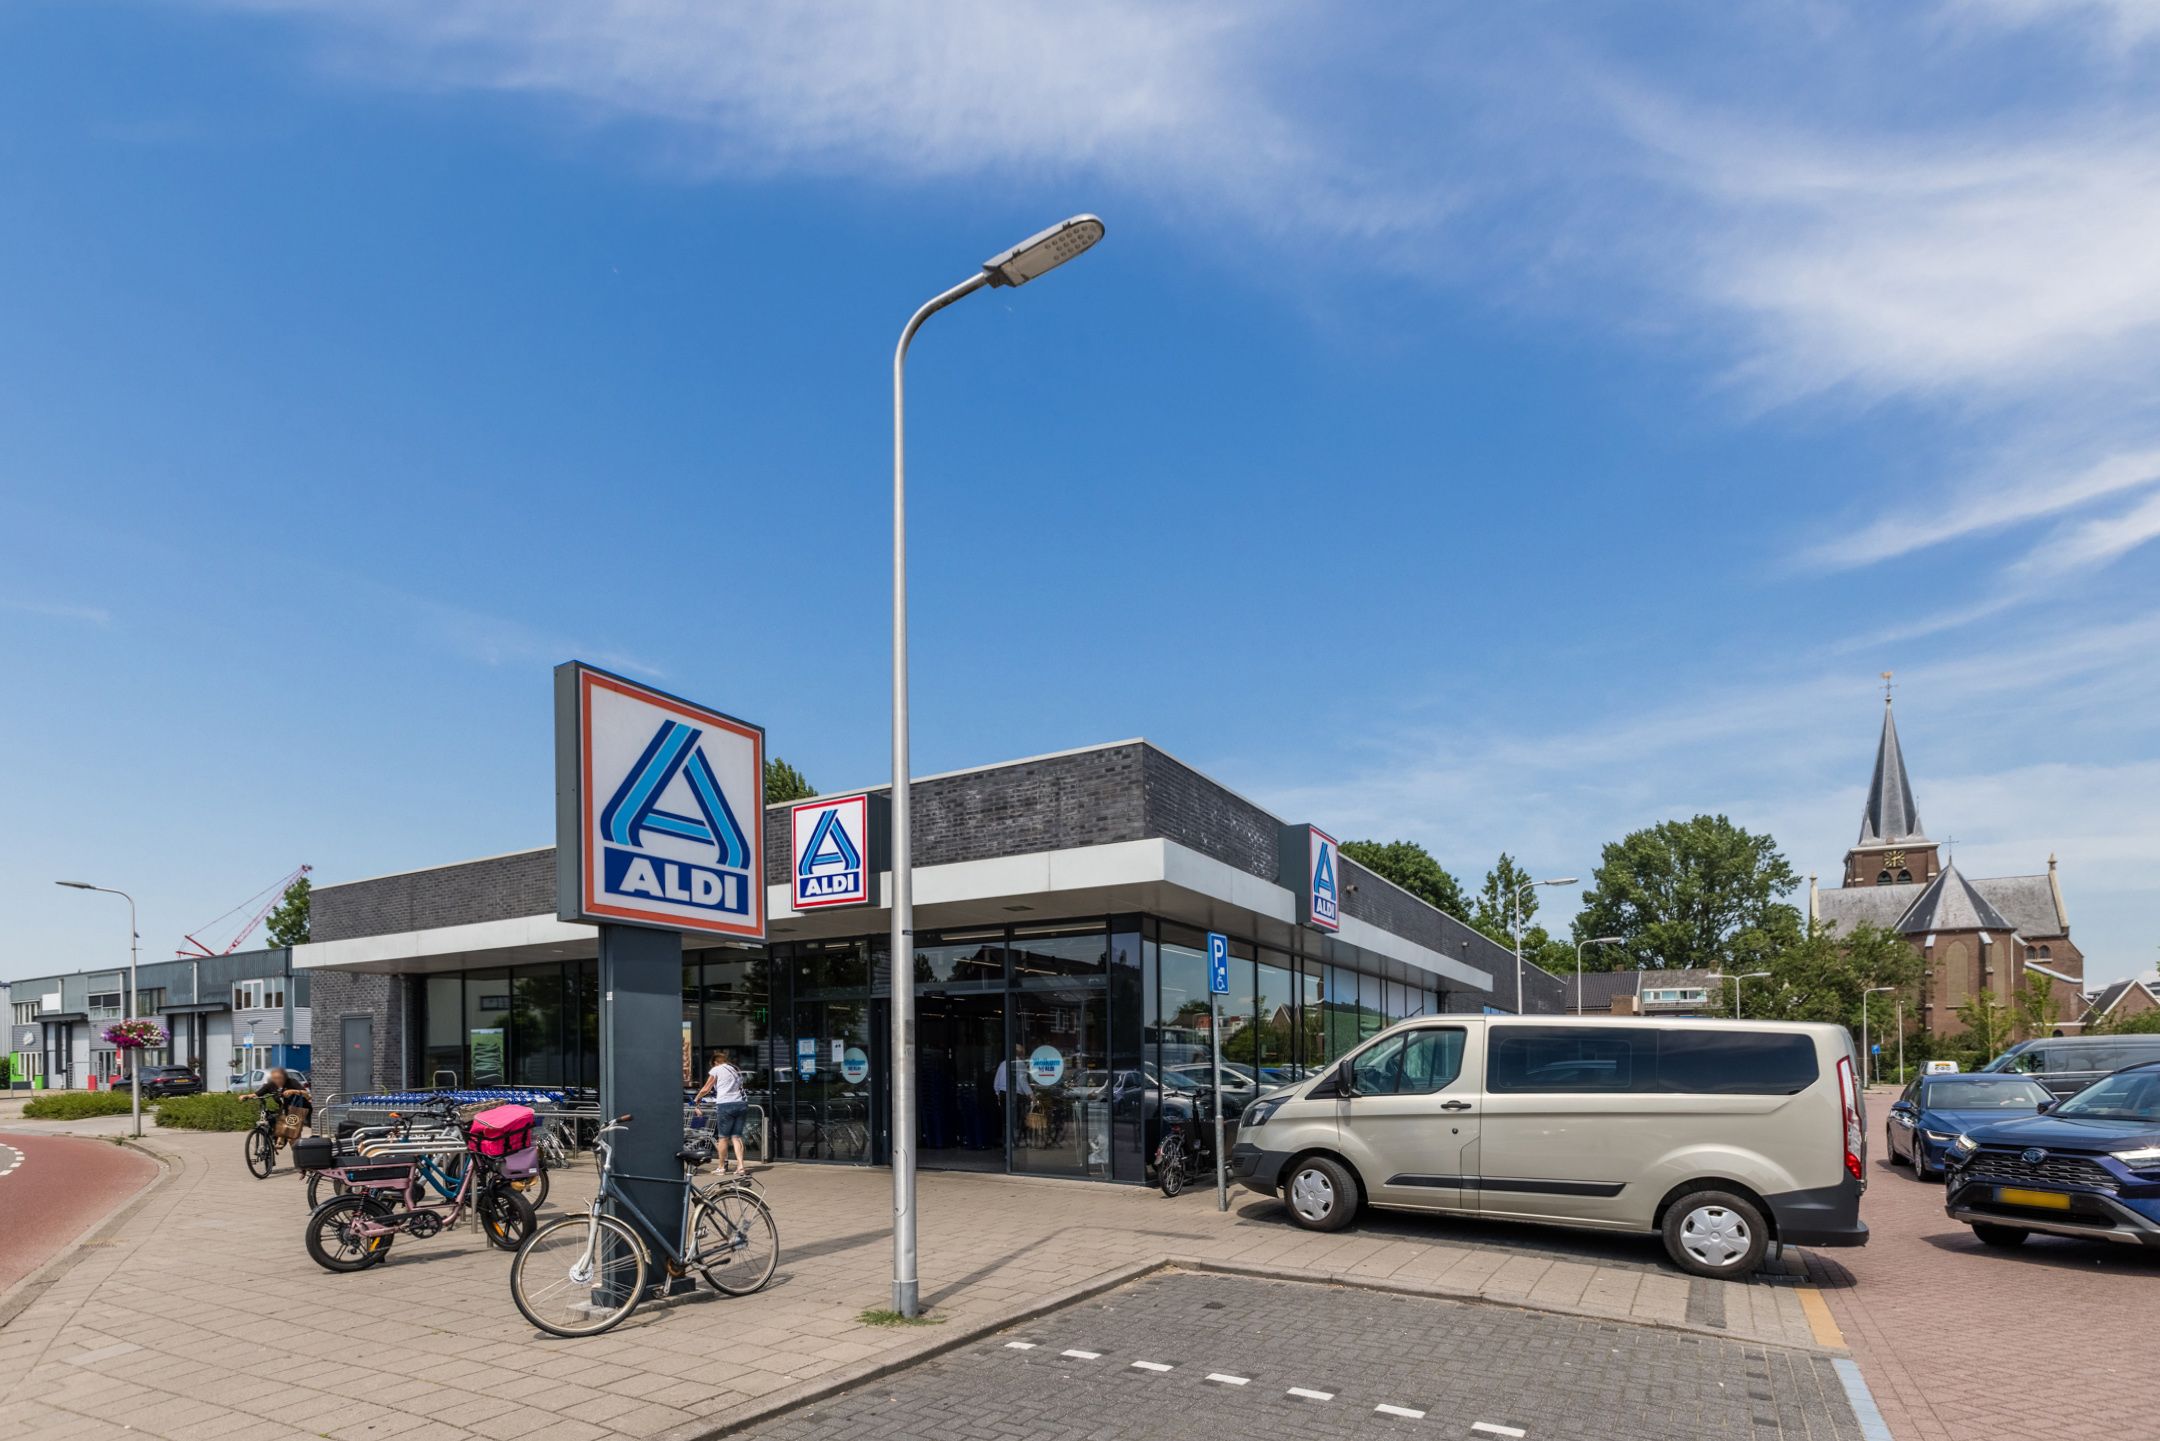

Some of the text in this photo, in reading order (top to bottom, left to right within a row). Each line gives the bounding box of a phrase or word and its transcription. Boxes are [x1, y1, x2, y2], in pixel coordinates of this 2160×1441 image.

[619, 856, 738, 910] ALDI
[804, 873, 854, 896] ALDI
[1316, 897, 1335, 919] ALDI
[1213, 938, 1224, 968] P
